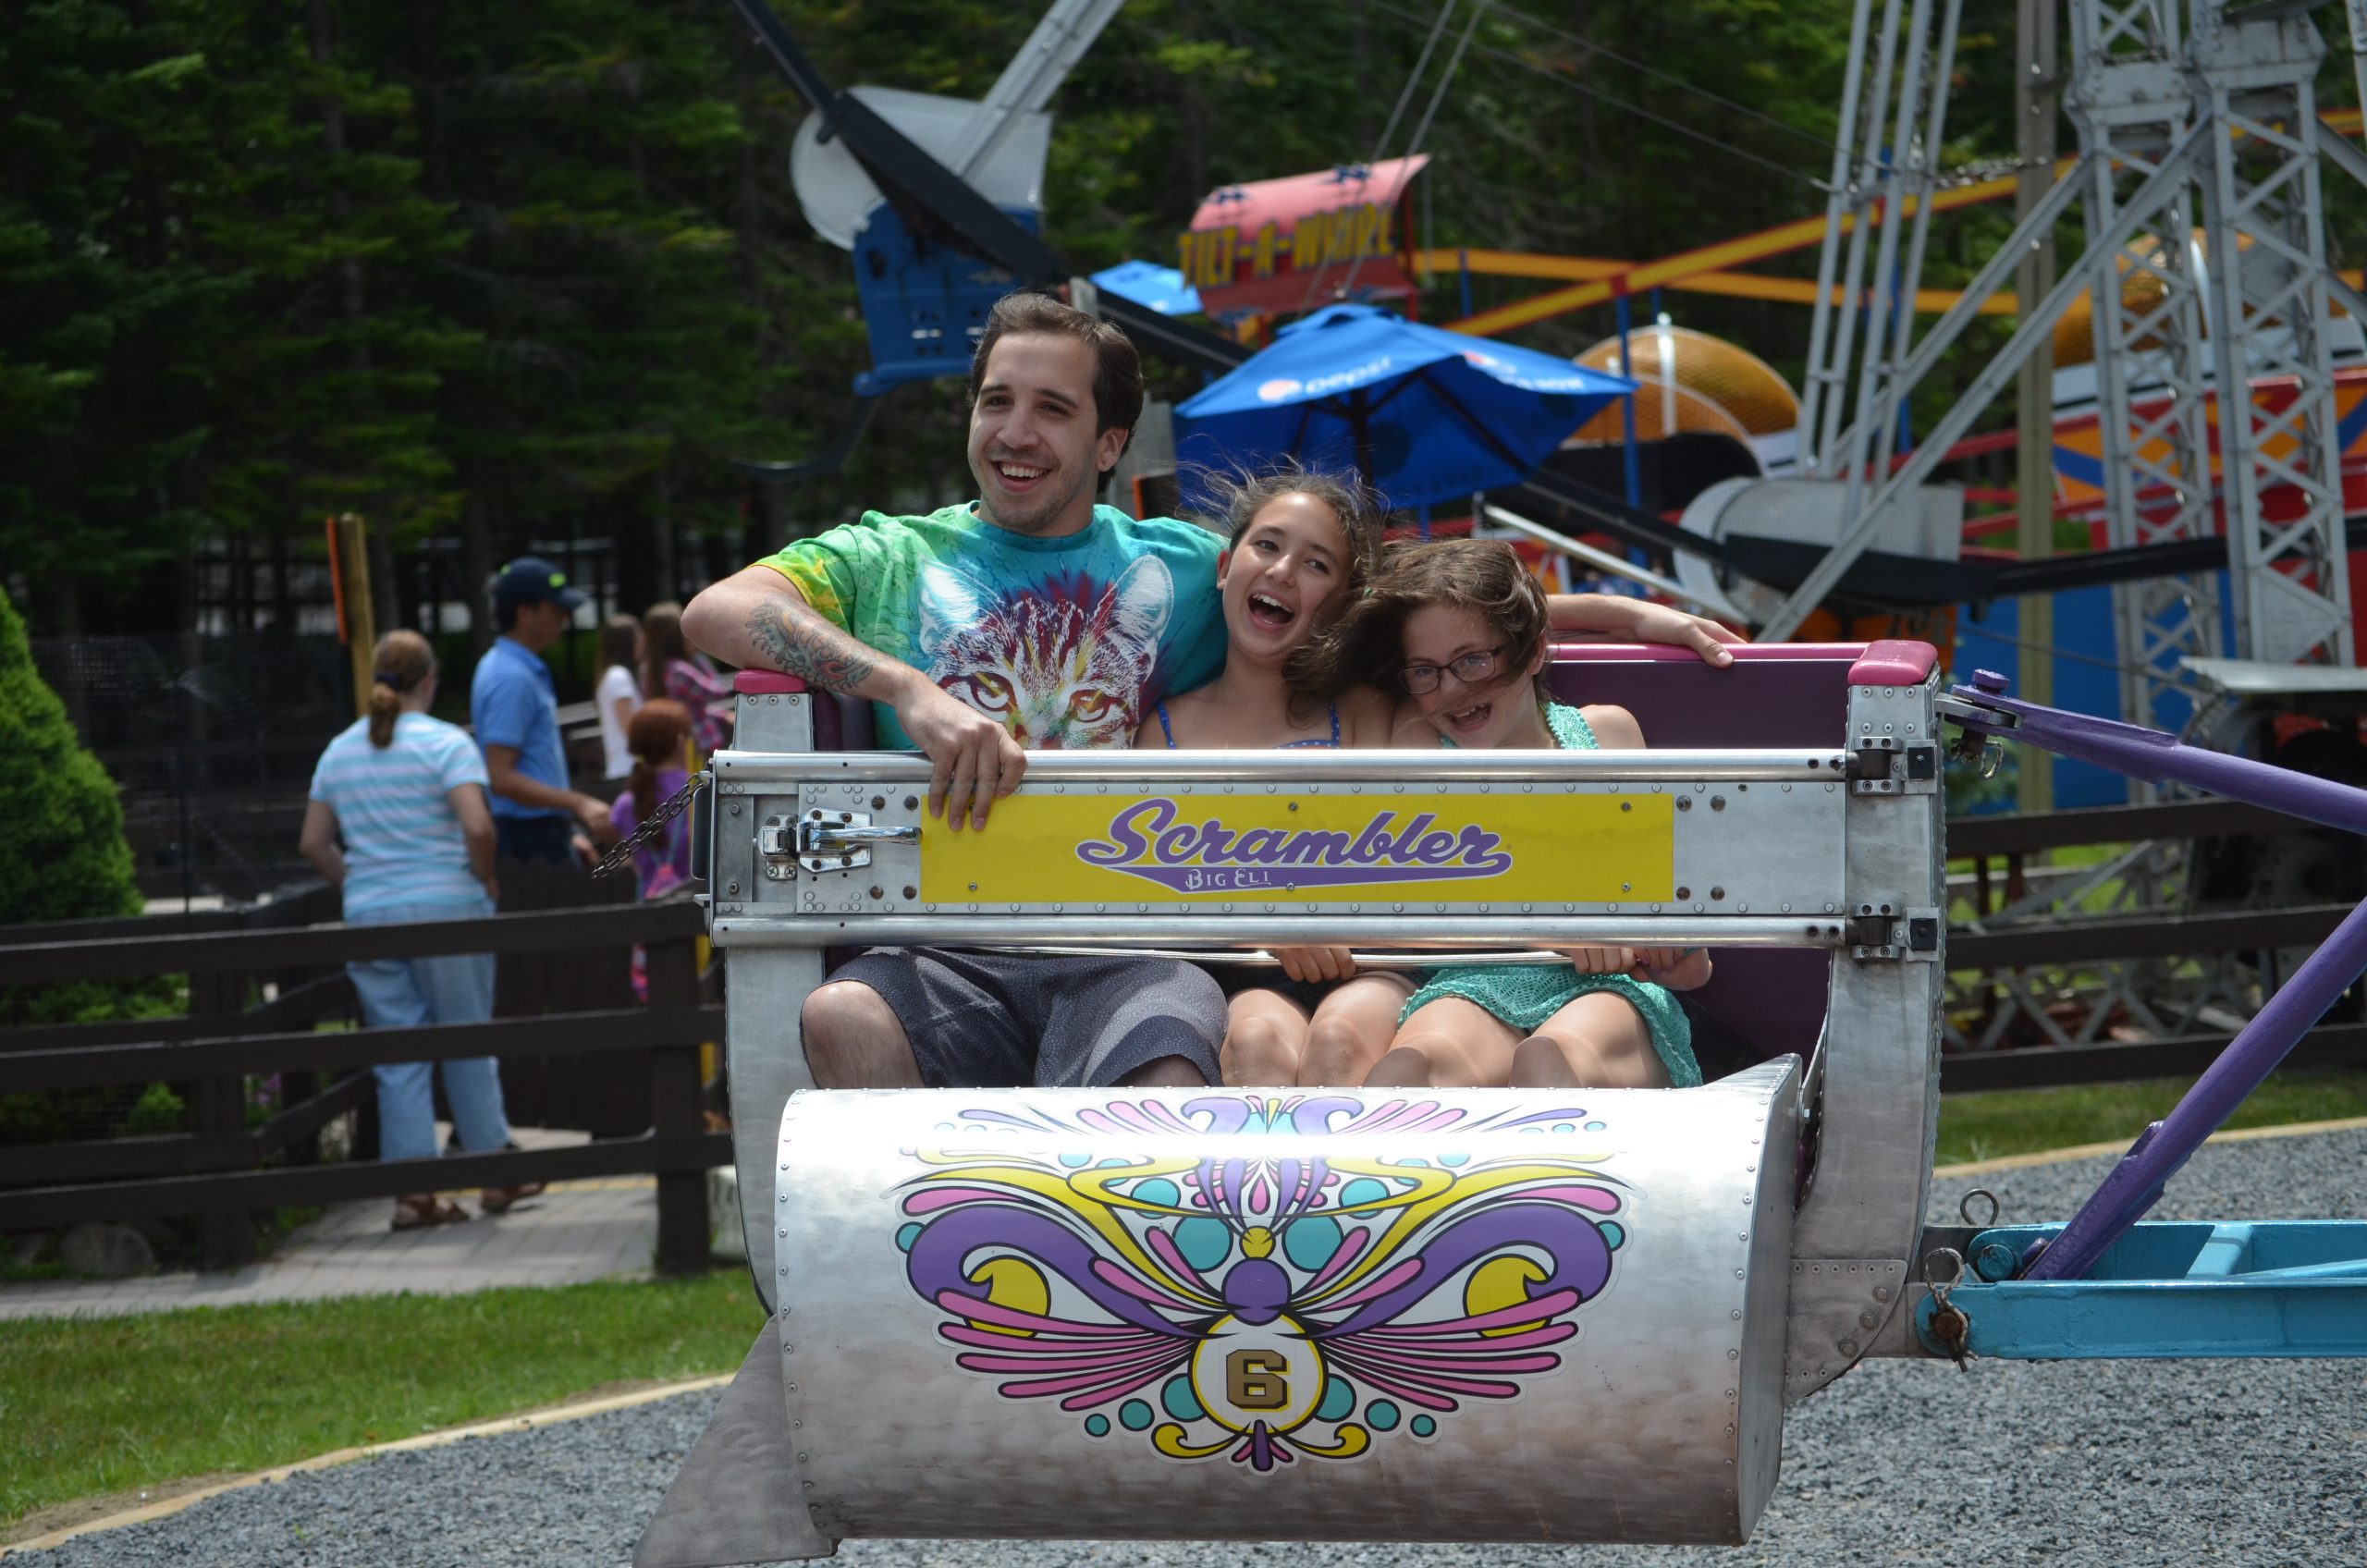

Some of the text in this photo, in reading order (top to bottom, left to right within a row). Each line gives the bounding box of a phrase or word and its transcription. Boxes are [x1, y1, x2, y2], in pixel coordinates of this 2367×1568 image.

[1075, 797, 1513, 867] Scrambler
[1185, 868, 1272, 890] BIG ELI
[1226, 1349, 1290, 1411] 6
